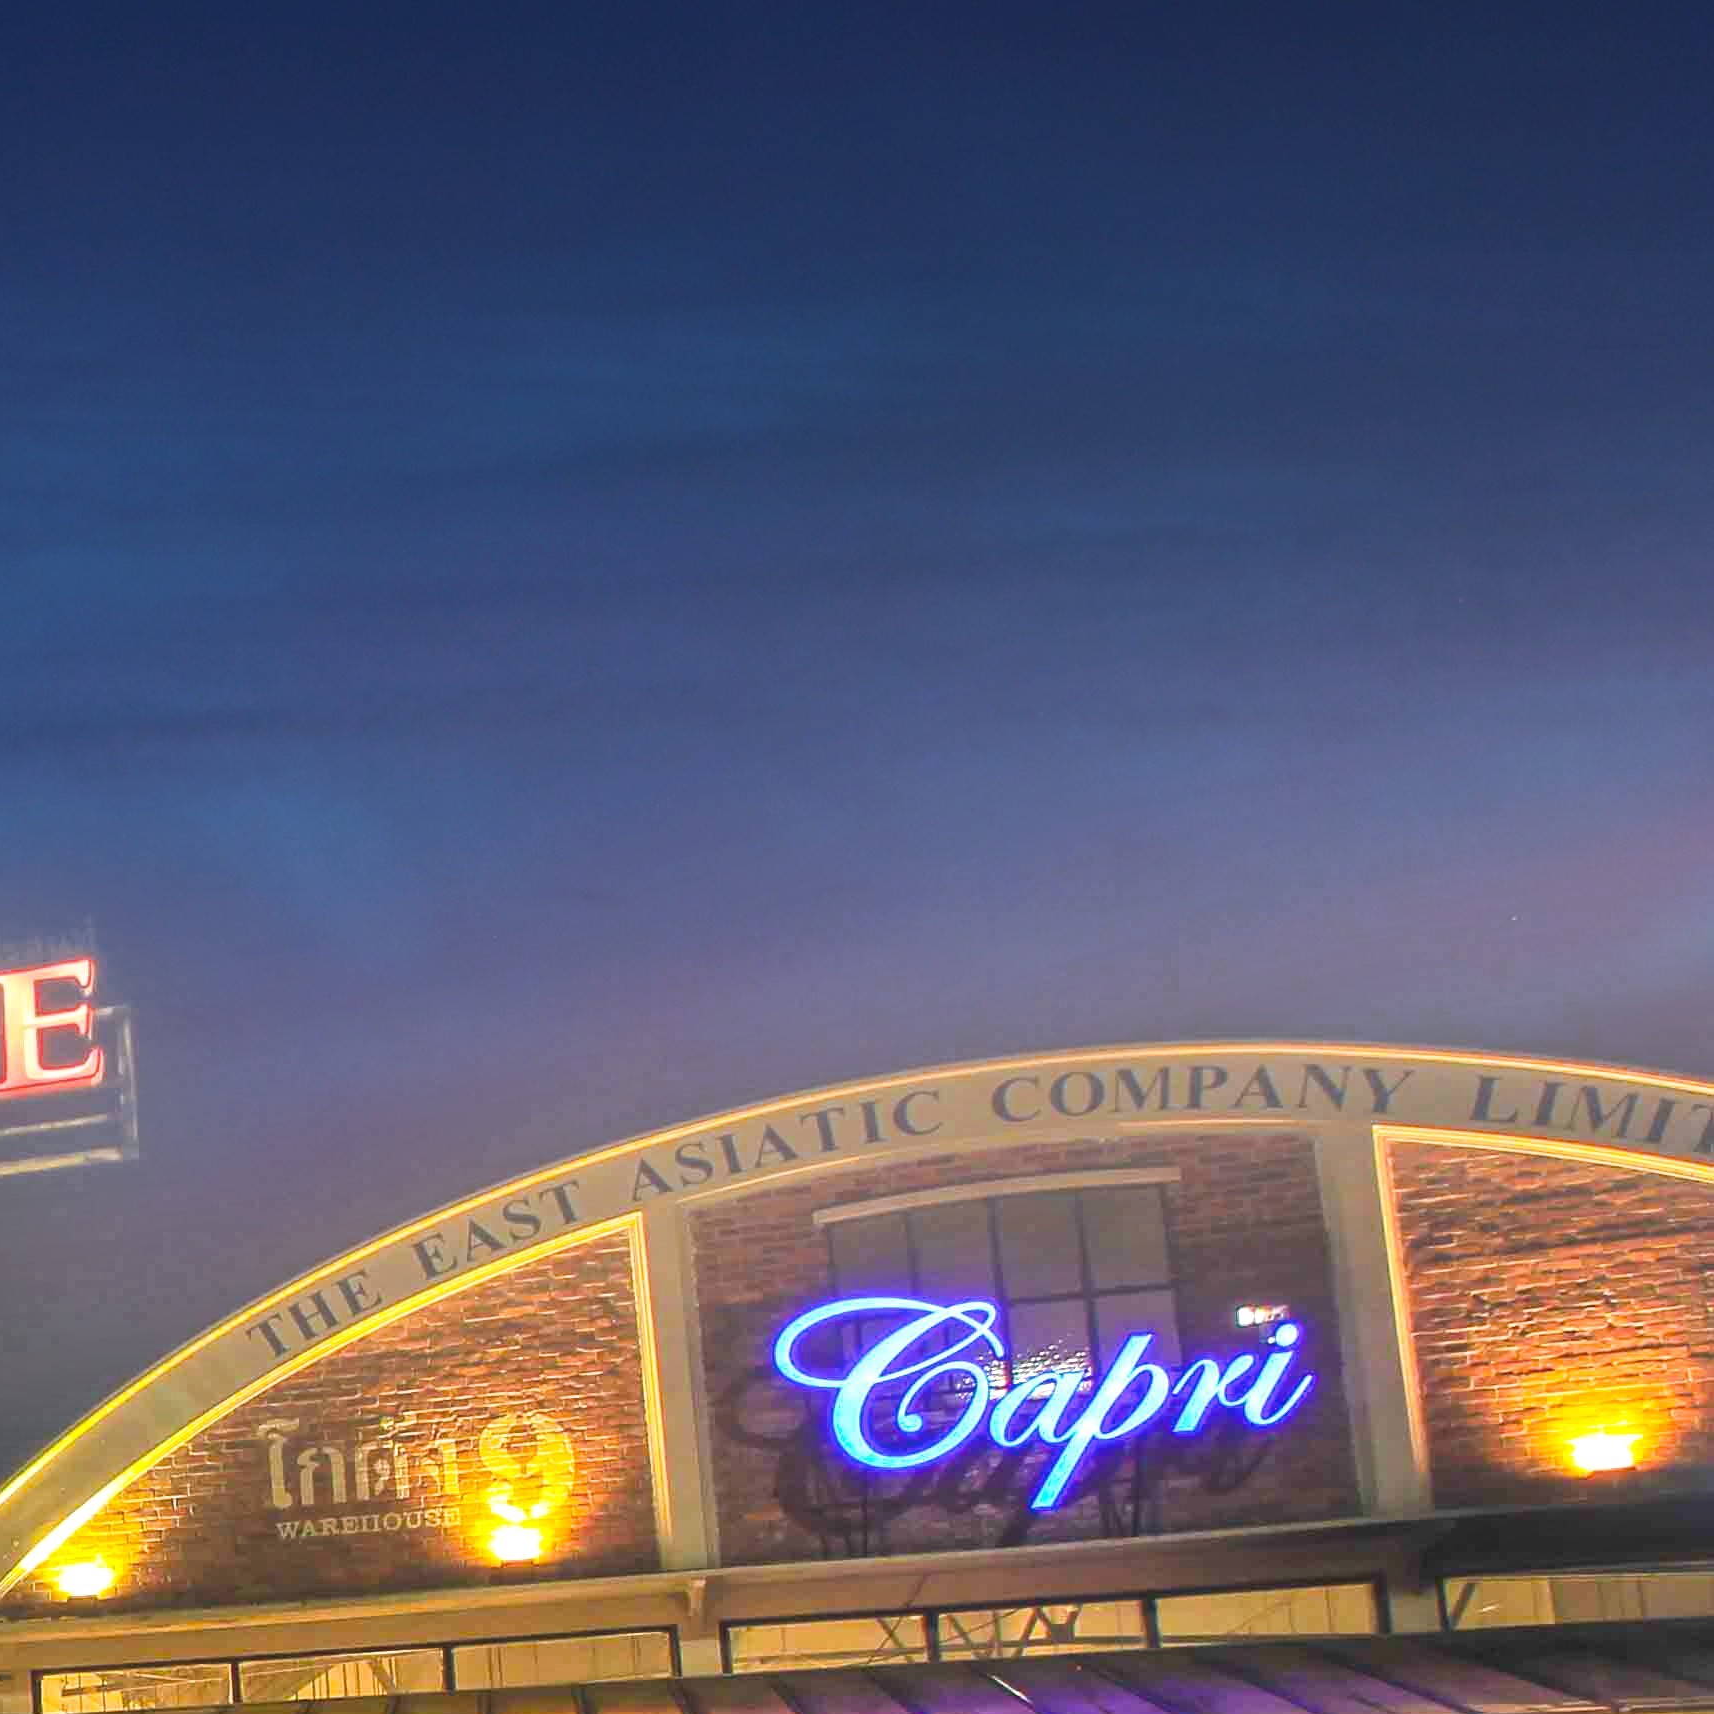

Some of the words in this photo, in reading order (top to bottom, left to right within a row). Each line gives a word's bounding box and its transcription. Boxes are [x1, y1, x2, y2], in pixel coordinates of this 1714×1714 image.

[245, 1265, 383, 1361] THE
[411, 1177, 582, 1281] EAST
[630, 1089, 944, 1203] ASIATIC
[989, 1062, 1416, 1124] COMPANY
[773, 1296, 1314, 1513] Capri
[275, 1507, 463, 1540] WAREHOUSE
